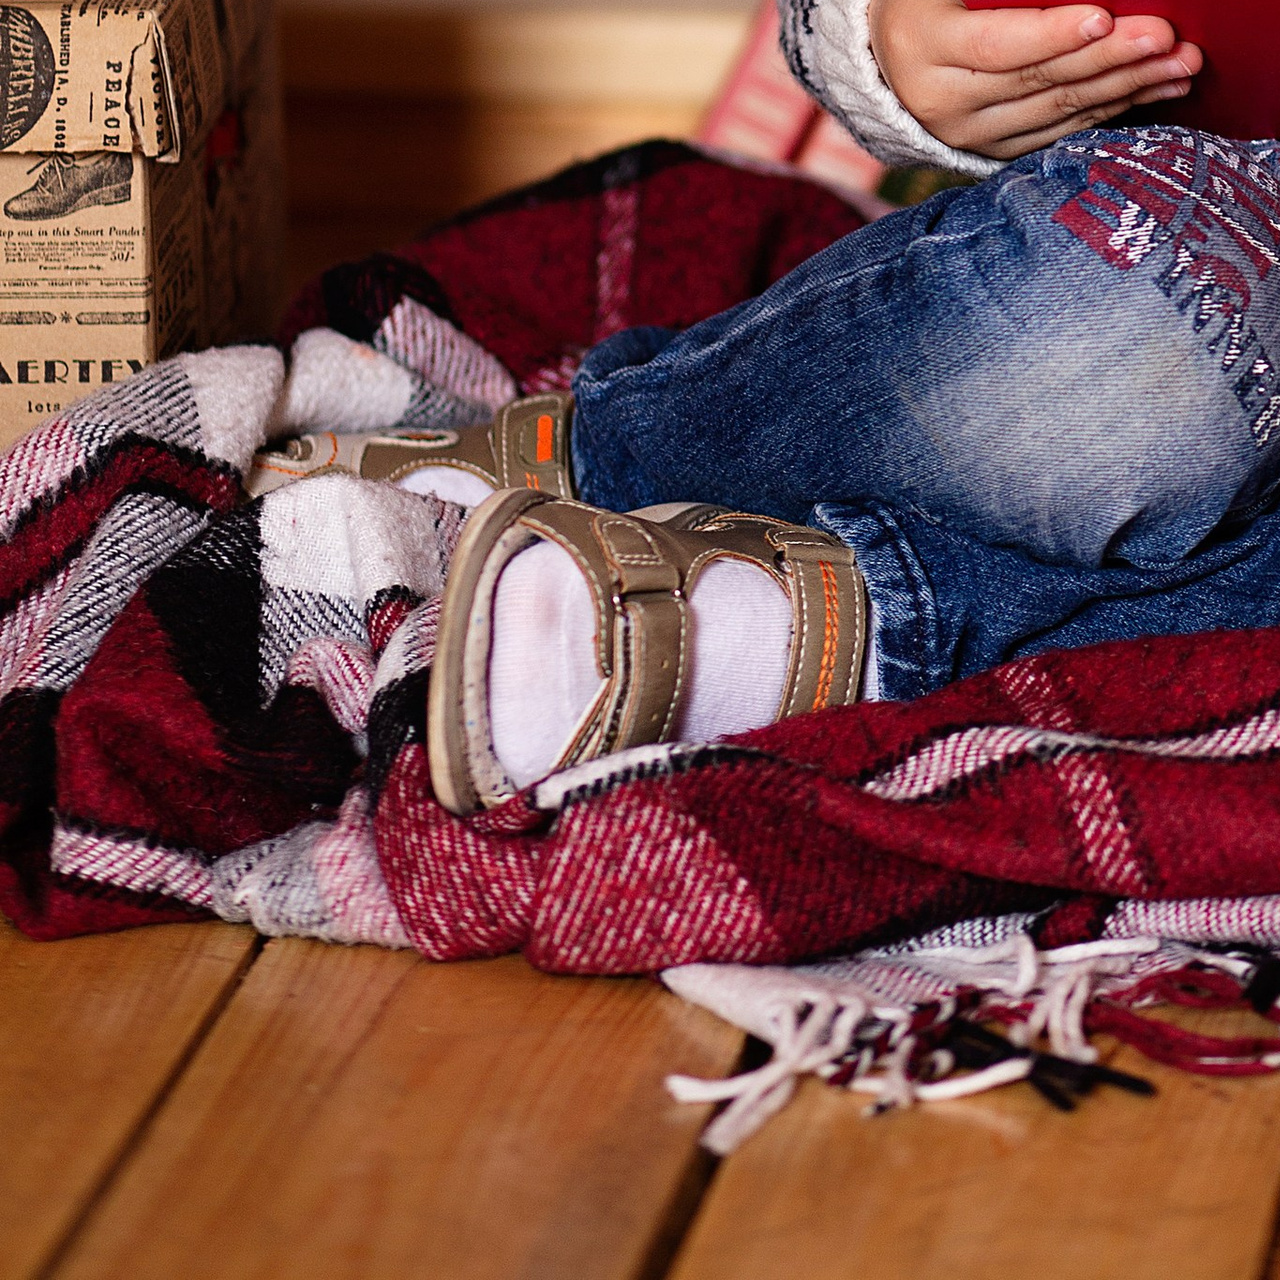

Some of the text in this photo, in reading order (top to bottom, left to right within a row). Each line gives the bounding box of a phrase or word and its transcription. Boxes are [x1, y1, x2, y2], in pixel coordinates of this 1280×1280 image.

[103, 60, 123, 148] PEACE
[38, 227, 48, 237] in
[52, 226, 70, 237] this
[74, 226, 104, 237] Smart
